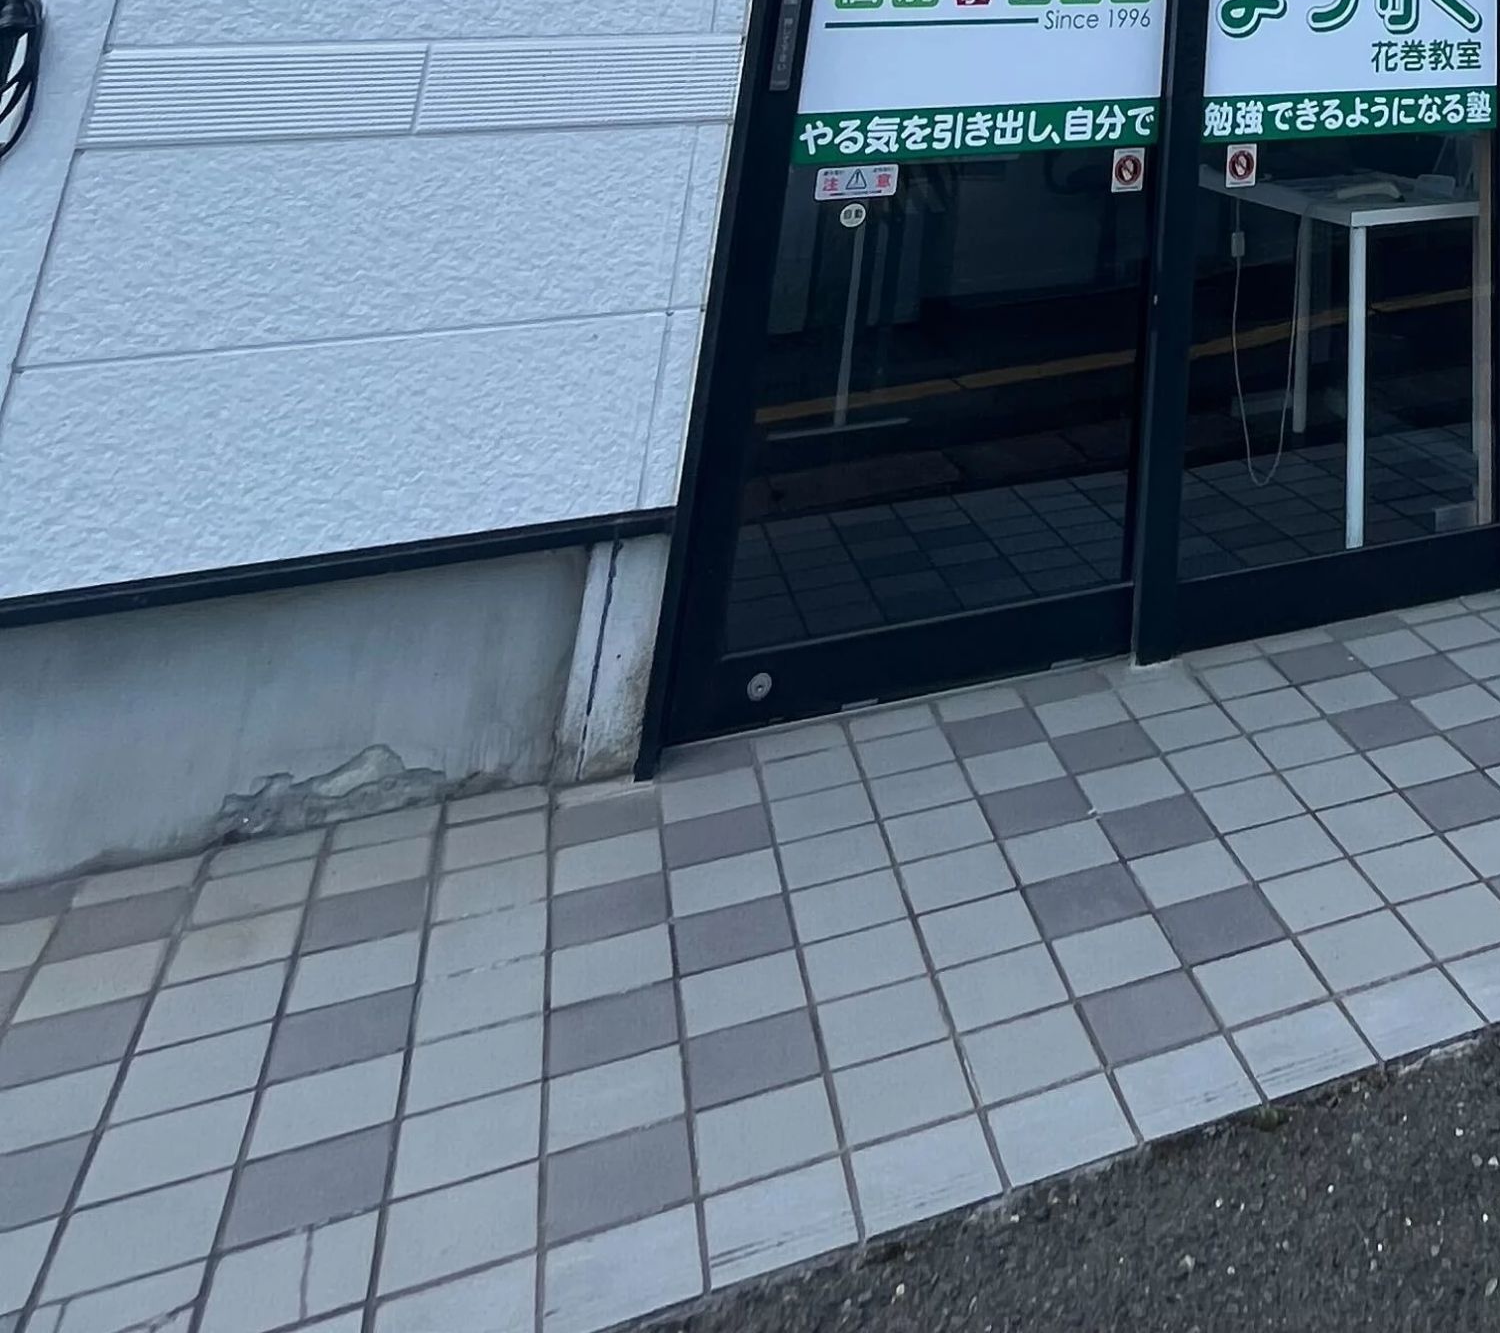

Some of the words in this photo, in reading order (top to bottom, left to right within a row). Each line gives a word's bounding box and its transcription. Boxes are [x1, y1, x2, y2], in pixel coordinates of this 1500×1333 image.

[1043, 9, 1099, 29] Since
[1107, 8, 1151, 29] 1996
[1370, 38, 1483, 73] 花巻教室
[798, 104, 1155, 155] やる気を引き出し、自分で
[1202, 89, 1492, 137] 勉強できるようになる塾
